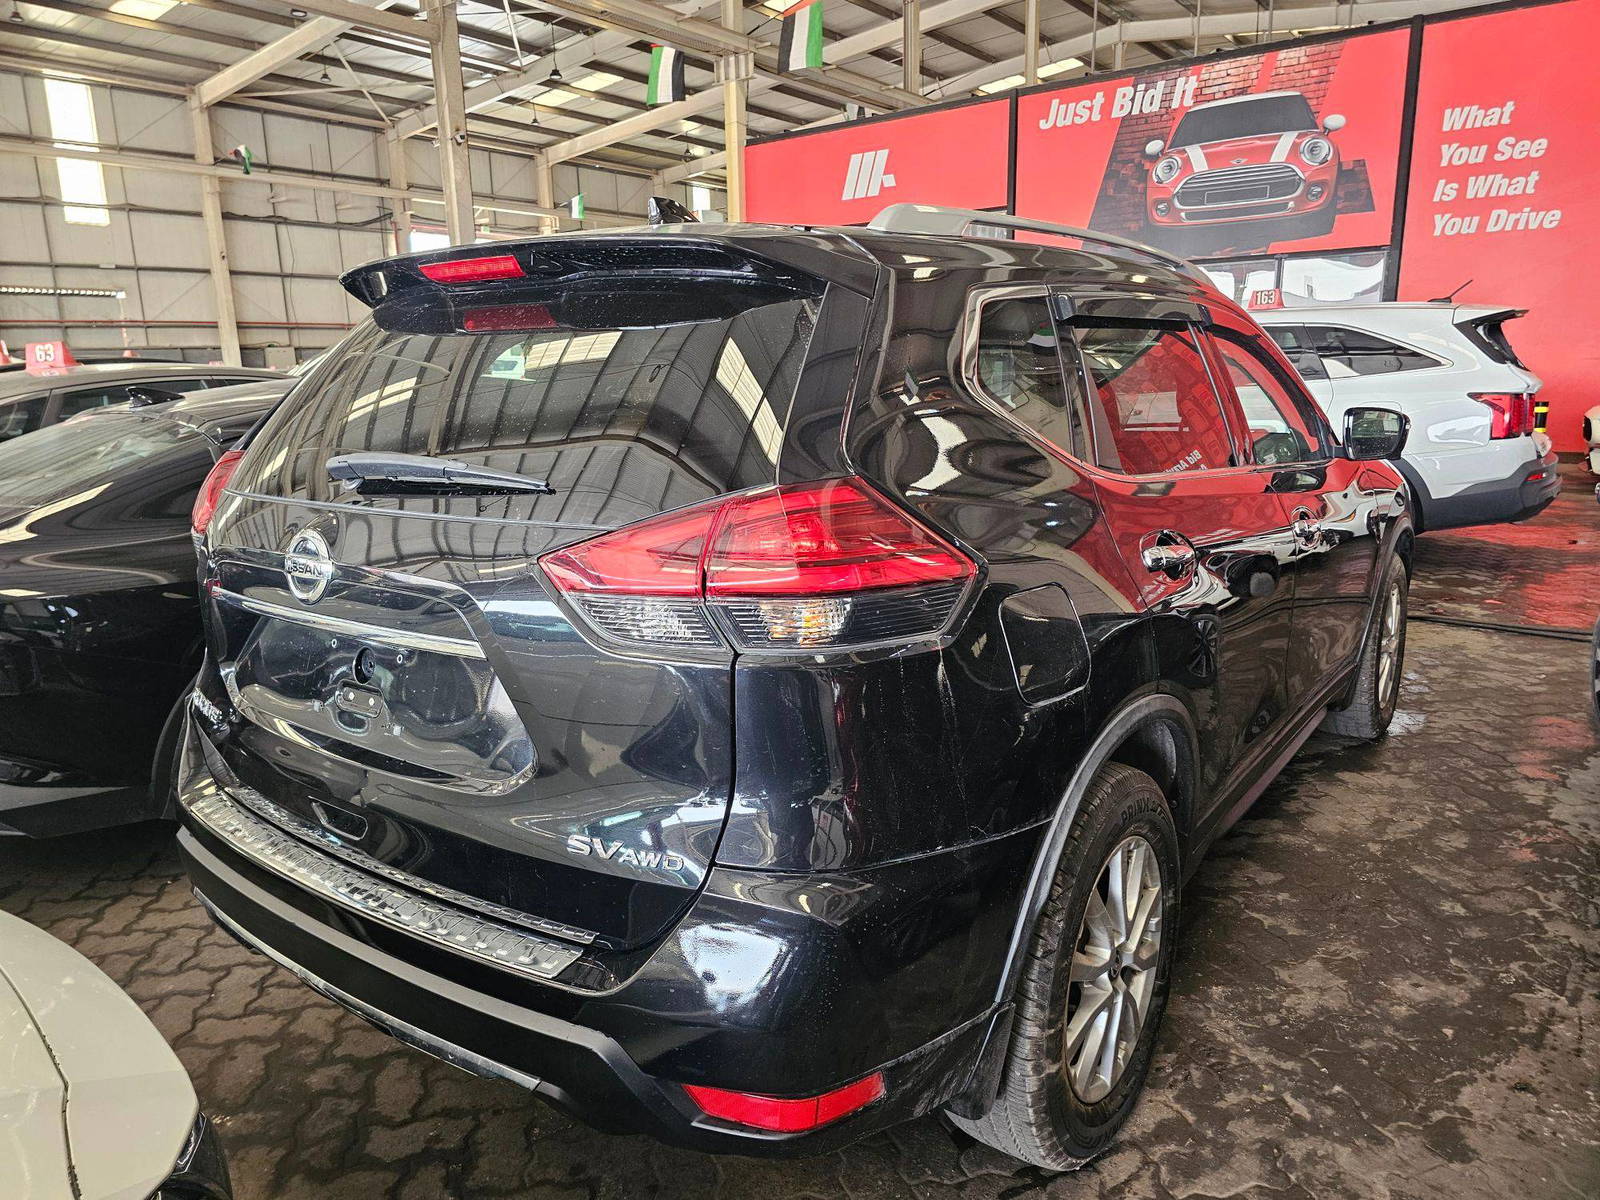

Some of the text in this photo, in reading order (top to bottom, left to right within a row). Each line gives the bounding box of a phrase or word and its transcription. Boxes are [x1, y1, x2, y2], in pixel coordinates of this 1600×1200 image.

[1039, 75, 1199, 130] Just Bid It
[1442, 101, 1516, 132] What
[1440, 136, 1549, 167] You See
[1432, 170, 1540, 202] Is What
[1433, 207, 1562, 236] You Drive
[1256, 291, 1275, 305] 163
[35, 344, 54, 362] 63
[285, 559, 323, 578] NISSAN
[566, 834, 685, 871] SV AWD
